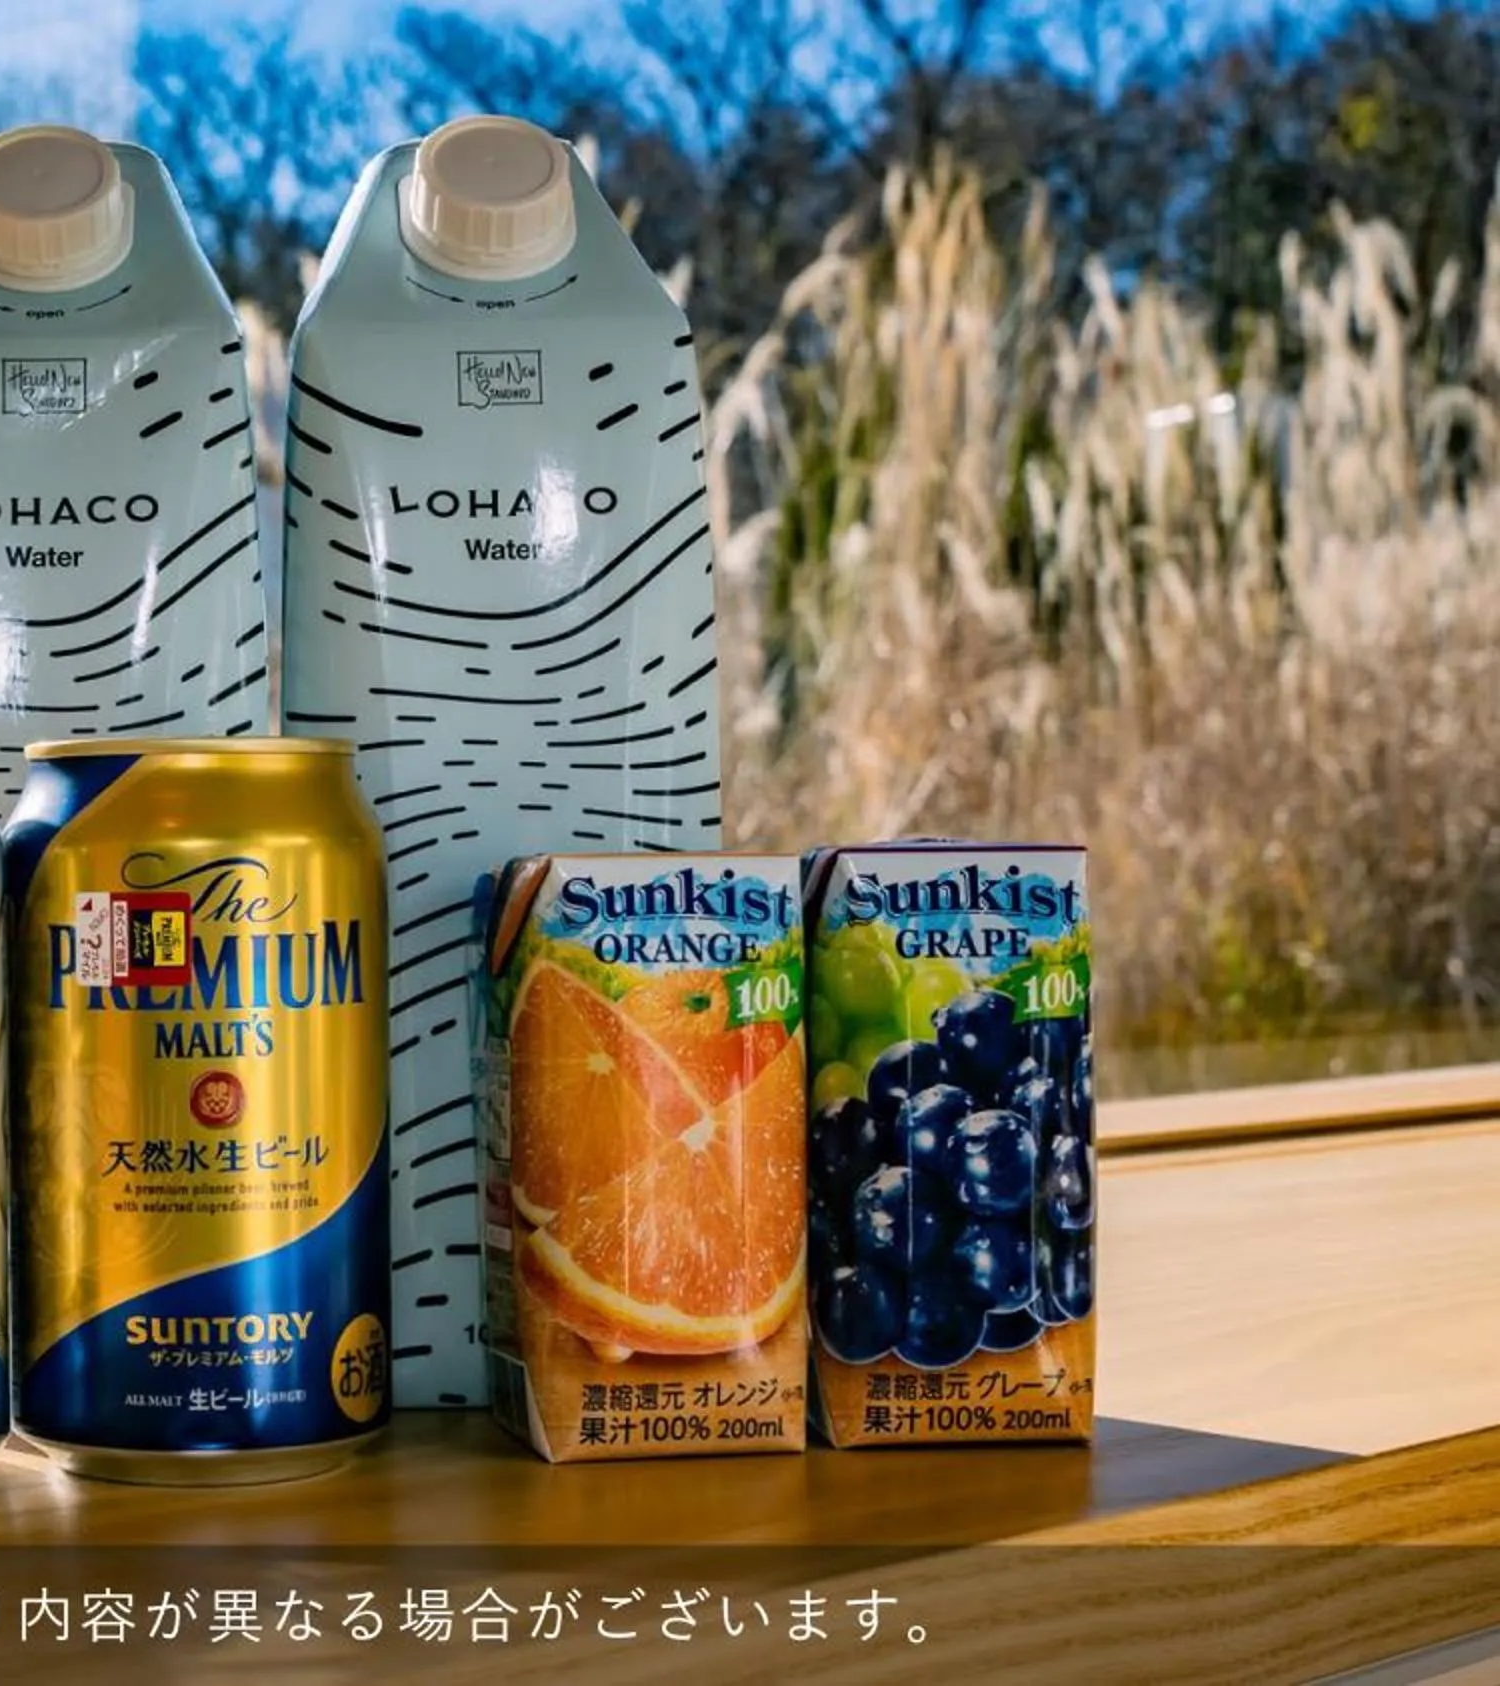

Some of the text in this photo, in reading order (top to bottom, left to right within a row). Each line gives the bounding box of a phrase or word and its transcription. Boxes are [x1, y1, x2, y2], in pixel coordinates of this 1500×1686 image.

[25, 309, 65, 319] open
[476, 300, 515, 310] open
[389, 486, 618, 518] LOHAO
[5, 546, 84, 567] Water
[464, 539, 541, 560] Water
[121, 851, 298, 923] The
[560, 867, 793, 931] Sunkist
[846, 864, 1080, 928] Sunkist
[594, 933, 761, 964] ORANGE
[896, 928, 1032, 959] GRAPE
[48, 919, 365, 1010] PMIUM
[155, 1014, 274, 1058] MALT'S
[135, 1183, 188, 1197] premium
[193, 1182, 235, 1197] pilsner
[114, 1201, 138, 1213] with
[143, 1200, 193, 1214] selected
[125, 1311, 314, 1346] SUNTORY
[125, 1394, 147, 1407] ALL
[149, 1394, 183, 1407] MALT
[188, 1387, 264, 1411] 生ビール
[693, 1378, 779, 1407] オレンジ
[978, 1368, 1066, 1400] グレープ
[580, 1414, 784, 1445] 果汁100% 200ml
[864, 1405, 1071, 1434] 果汁100% 200ml
